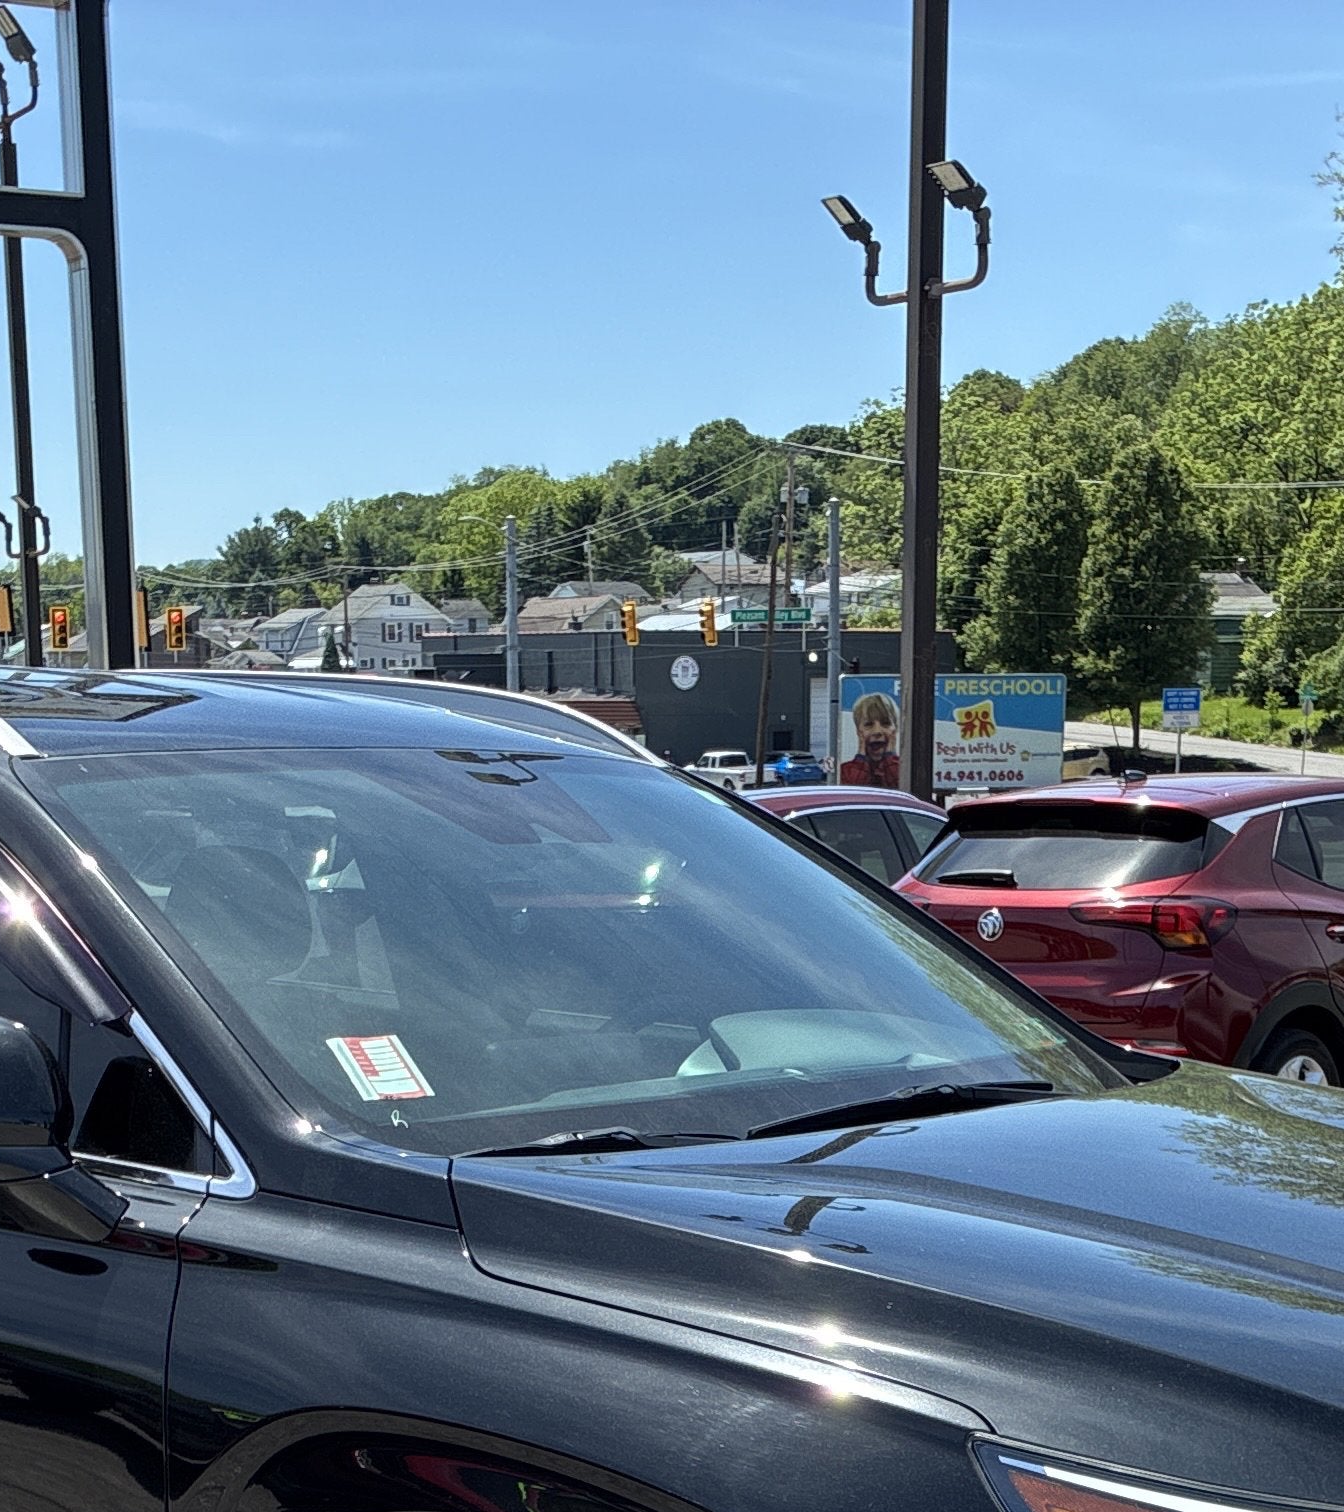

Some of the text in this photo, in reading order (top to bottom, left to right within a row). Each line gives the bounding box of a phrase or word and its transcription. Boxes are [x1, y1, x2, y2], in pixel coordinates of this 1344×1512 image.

[944, 679, 1062, 696] PRESCHOOL!
[936, 741, 1017, 757] Begin With Us
[935, 770, 1024, 782] 14.941.0606
